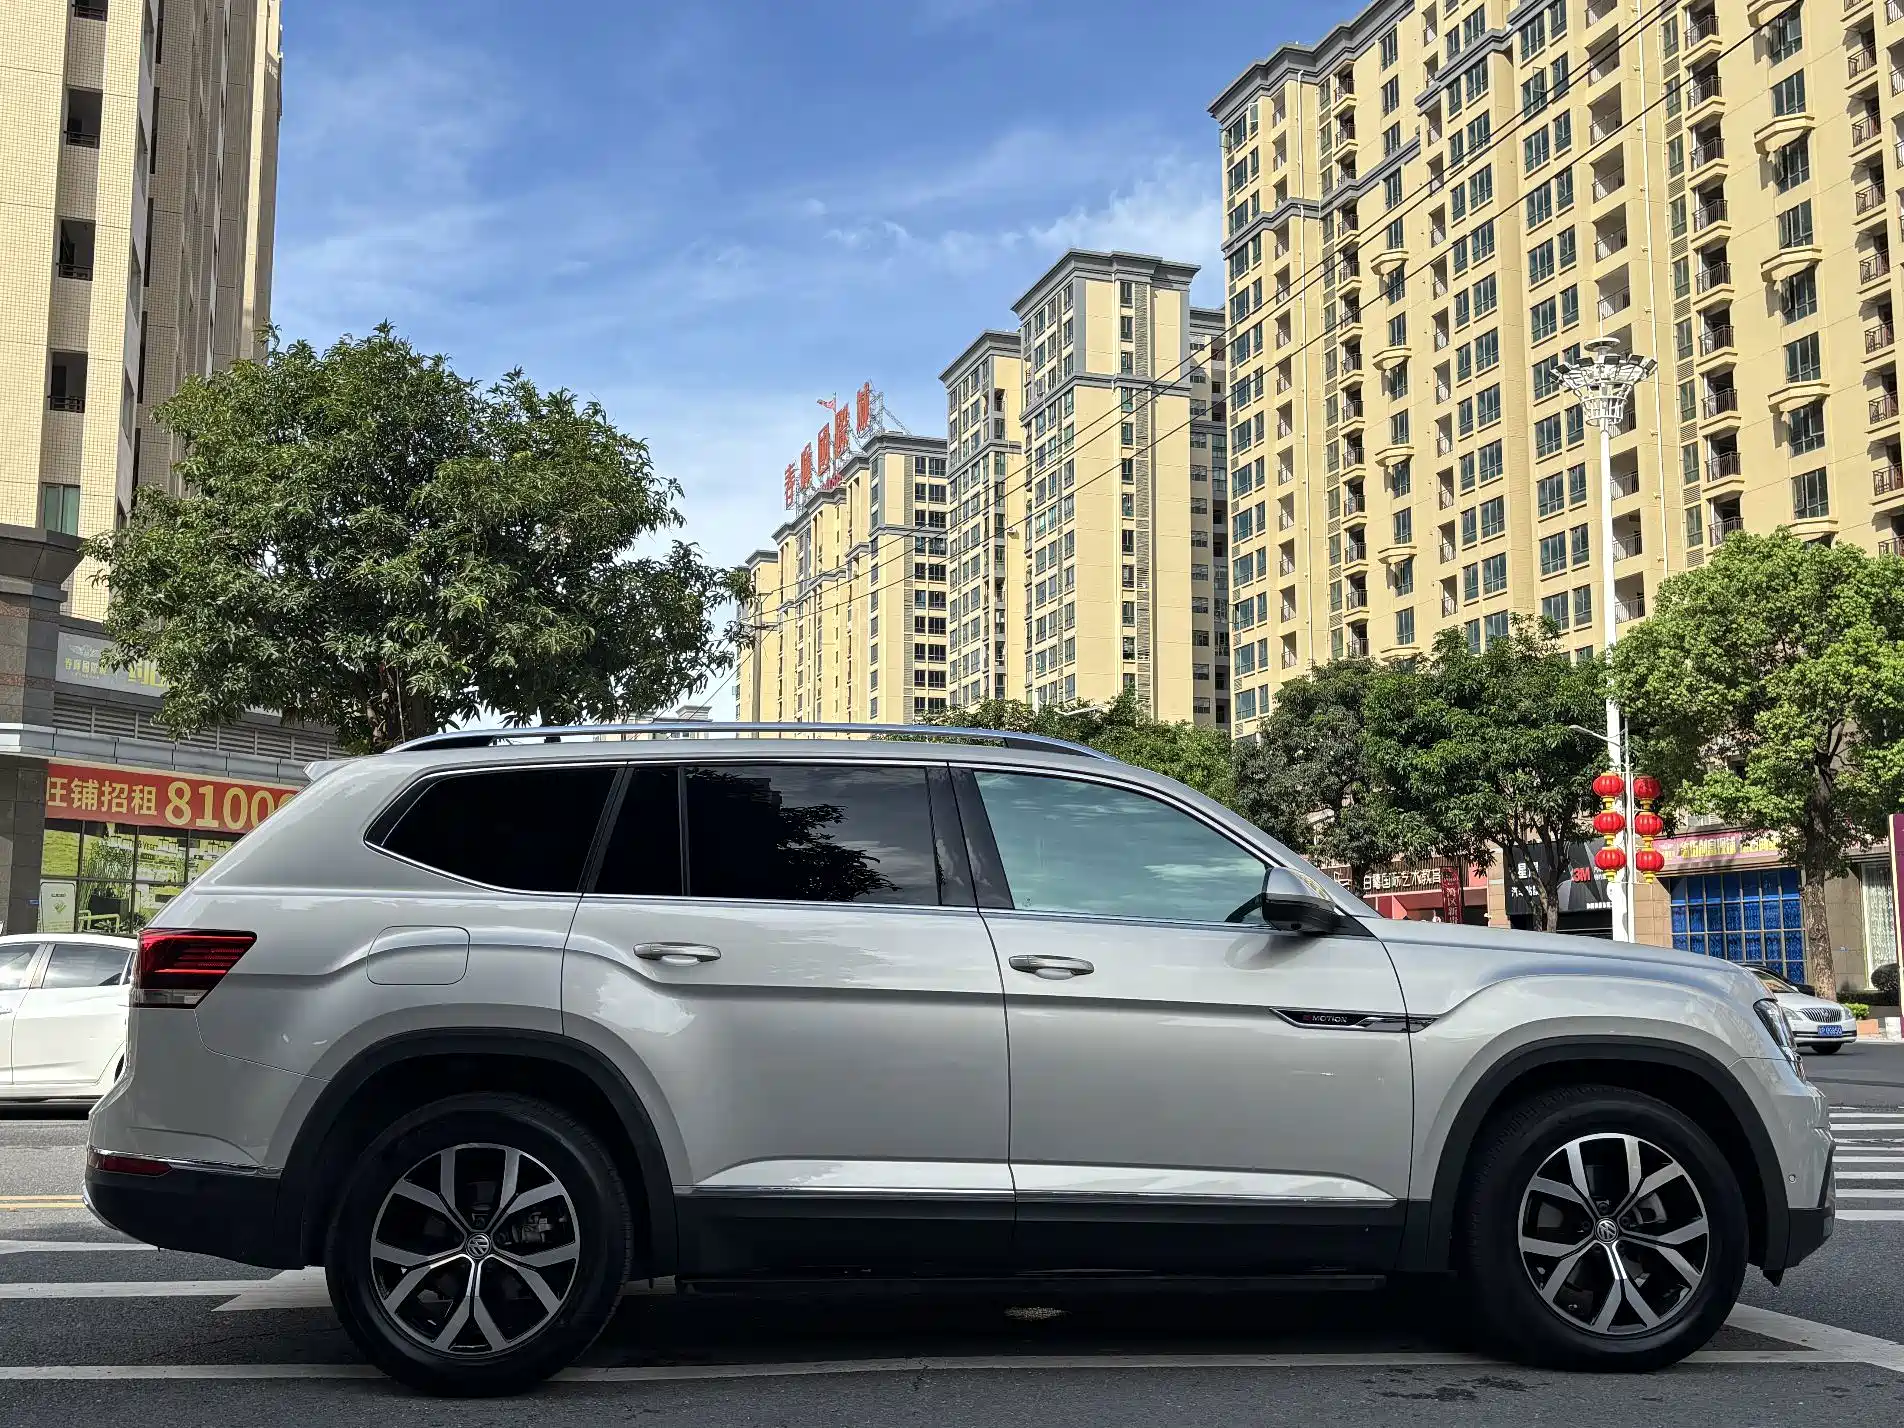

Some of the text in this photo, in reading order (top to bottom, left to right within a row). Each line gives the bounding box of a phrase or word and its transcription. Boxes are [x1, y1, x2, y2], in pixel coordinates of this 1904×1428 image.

[46, 776, 295, 830] 旺铺招租 8100
[1572, 866, 1592, 882] 3M
